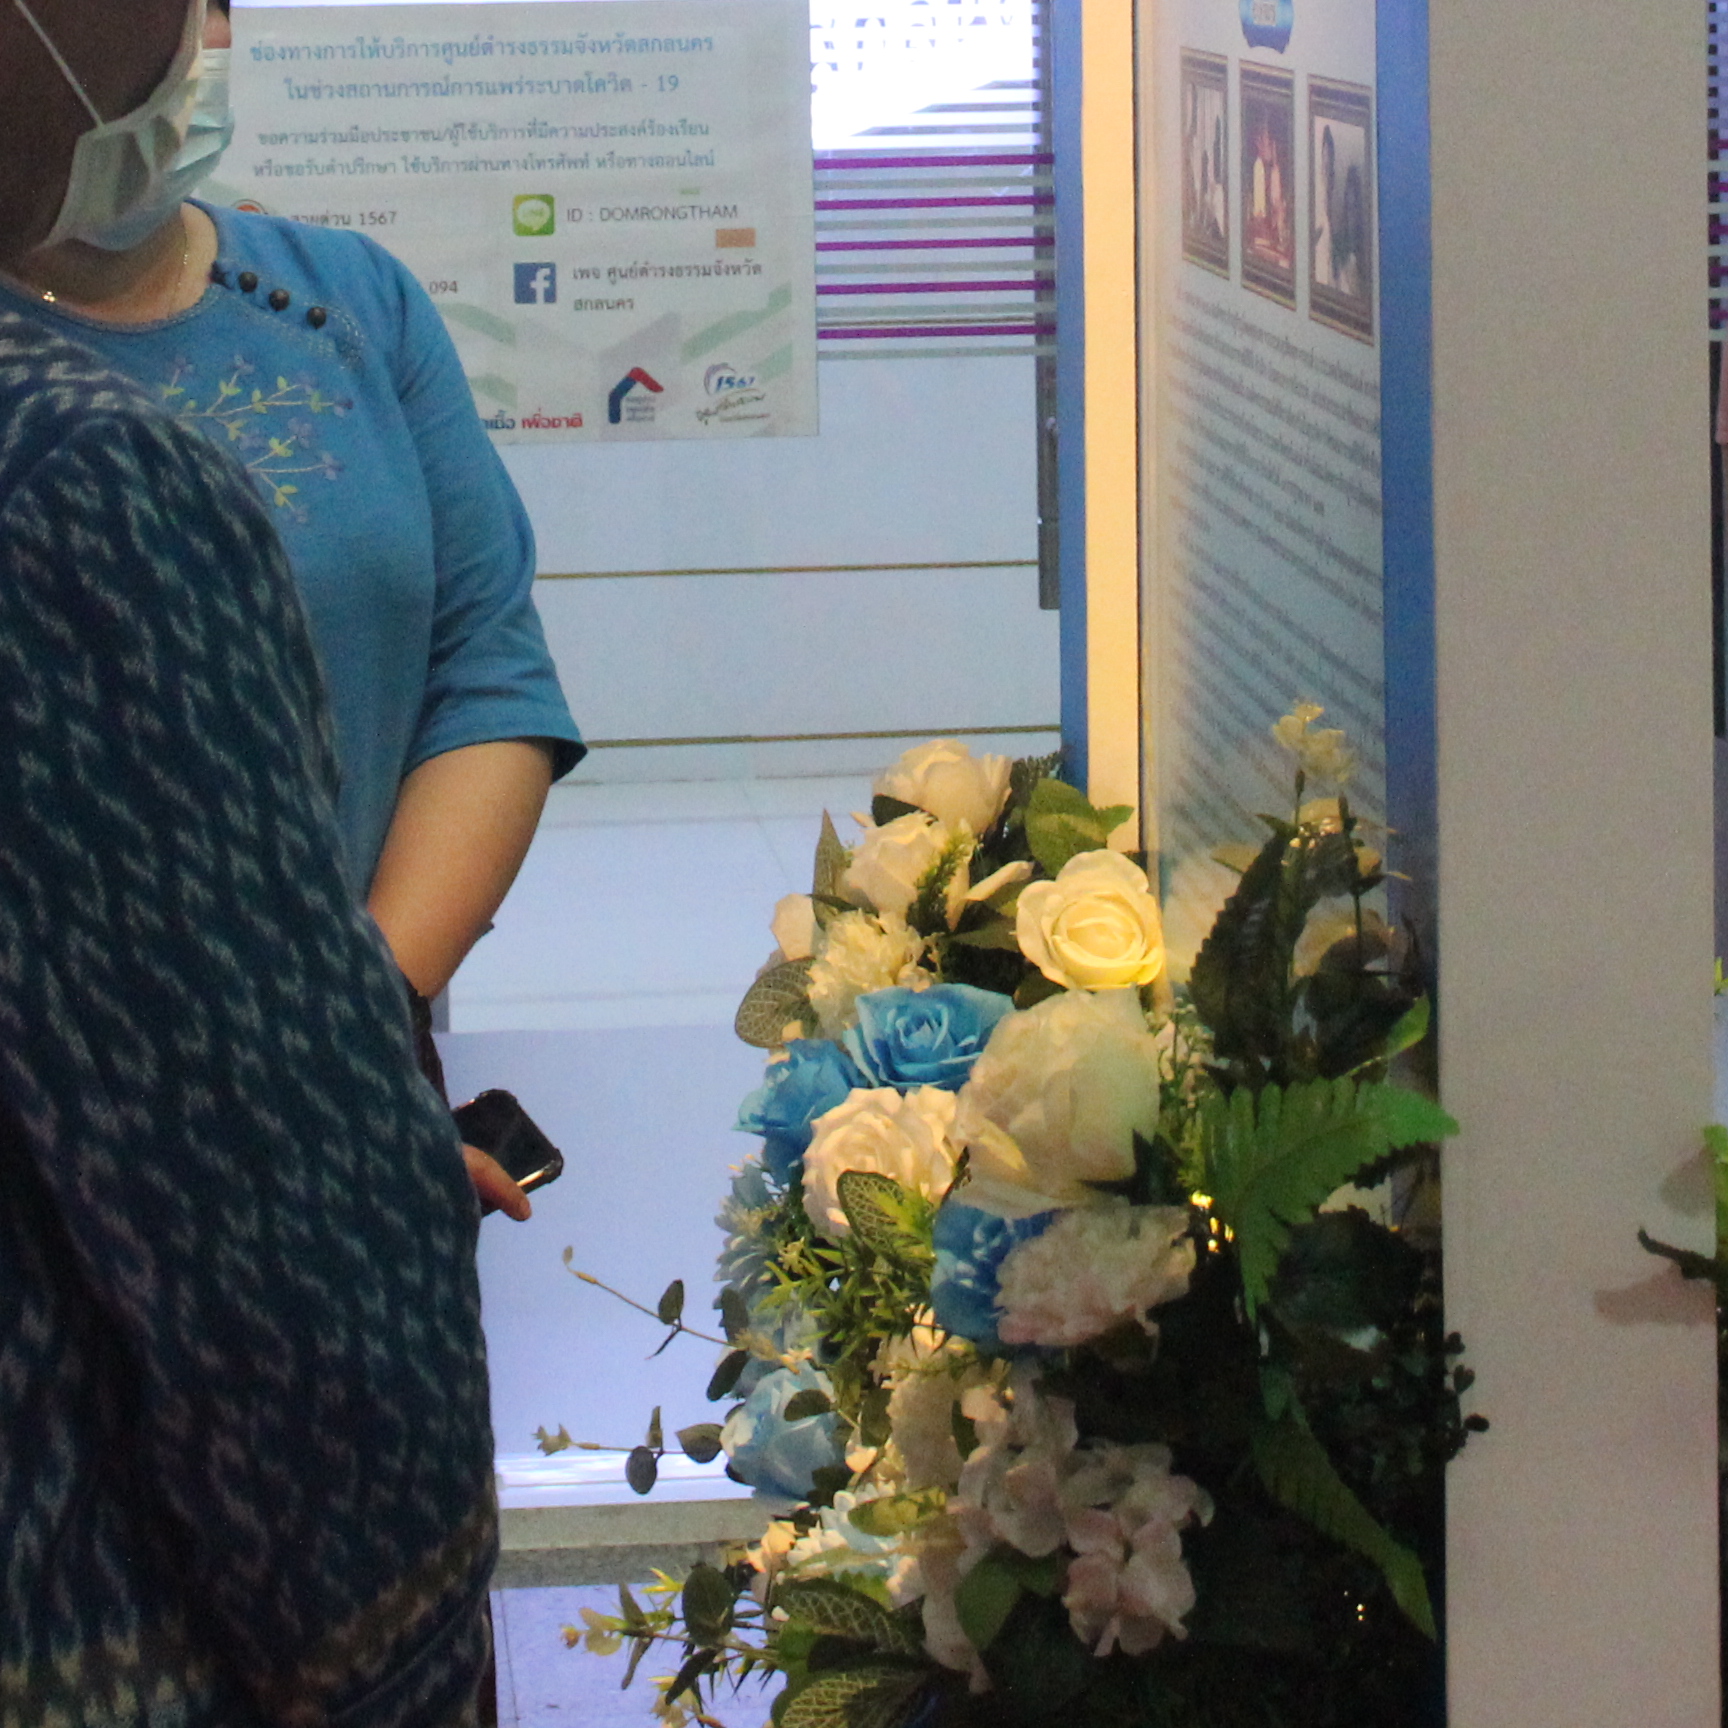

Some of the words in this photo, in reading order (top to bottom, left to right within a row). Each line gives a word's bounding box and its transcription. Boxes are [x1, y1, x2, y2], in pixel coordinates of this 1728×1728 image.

[657, 74, 680, 93] 19
[358, 210, 398, 226] 1567
[566, 207, 583, 222] ID
[599, 203, 739, 221] DOMRONGTHAM
[428, 279, 459, 295] 094
[481, 408, 516, 430] เชื้อ
